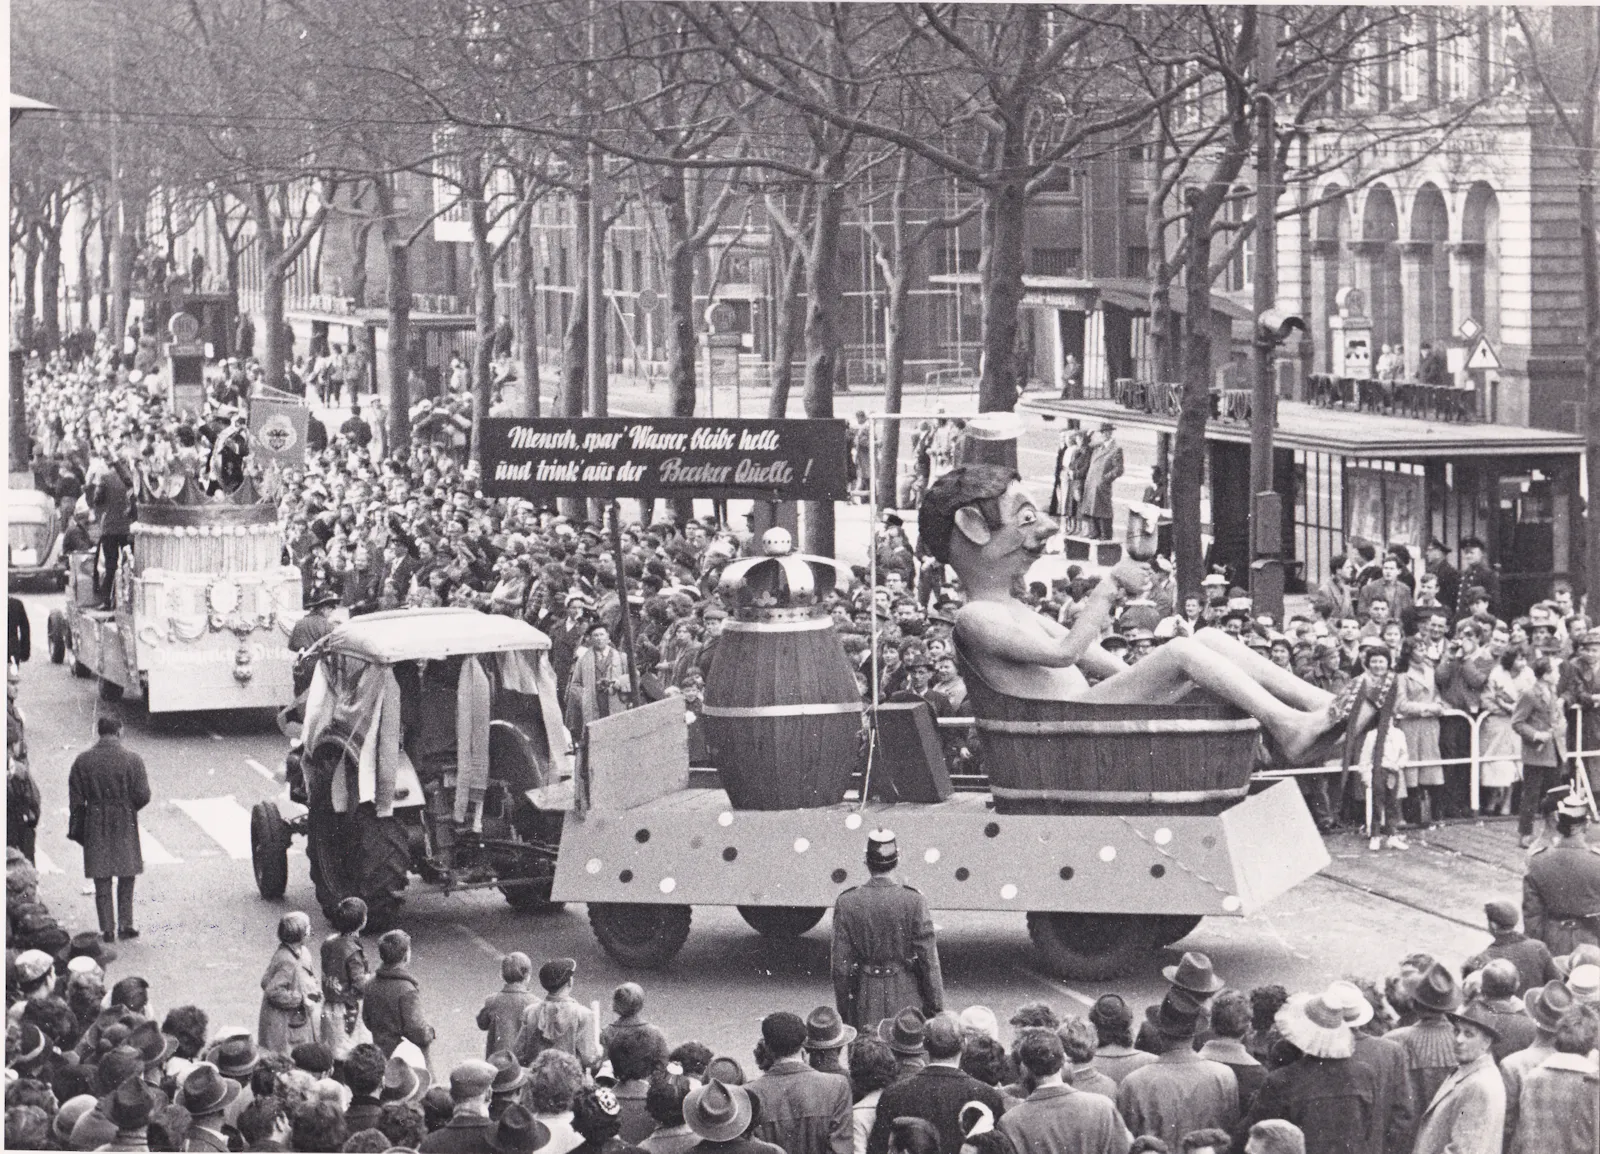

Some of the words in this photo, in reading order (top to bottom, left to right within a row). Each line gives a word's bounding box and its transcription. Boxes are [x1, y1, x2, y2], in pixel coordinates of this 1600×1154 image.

[508, 426, 580, 451] Mensch,
[629, 425, 688, 452] Wasser,
[690, 428, 737, 451] bleibe
[739, 428, 780, 451] helle
[617, 460, 648, 481] der
